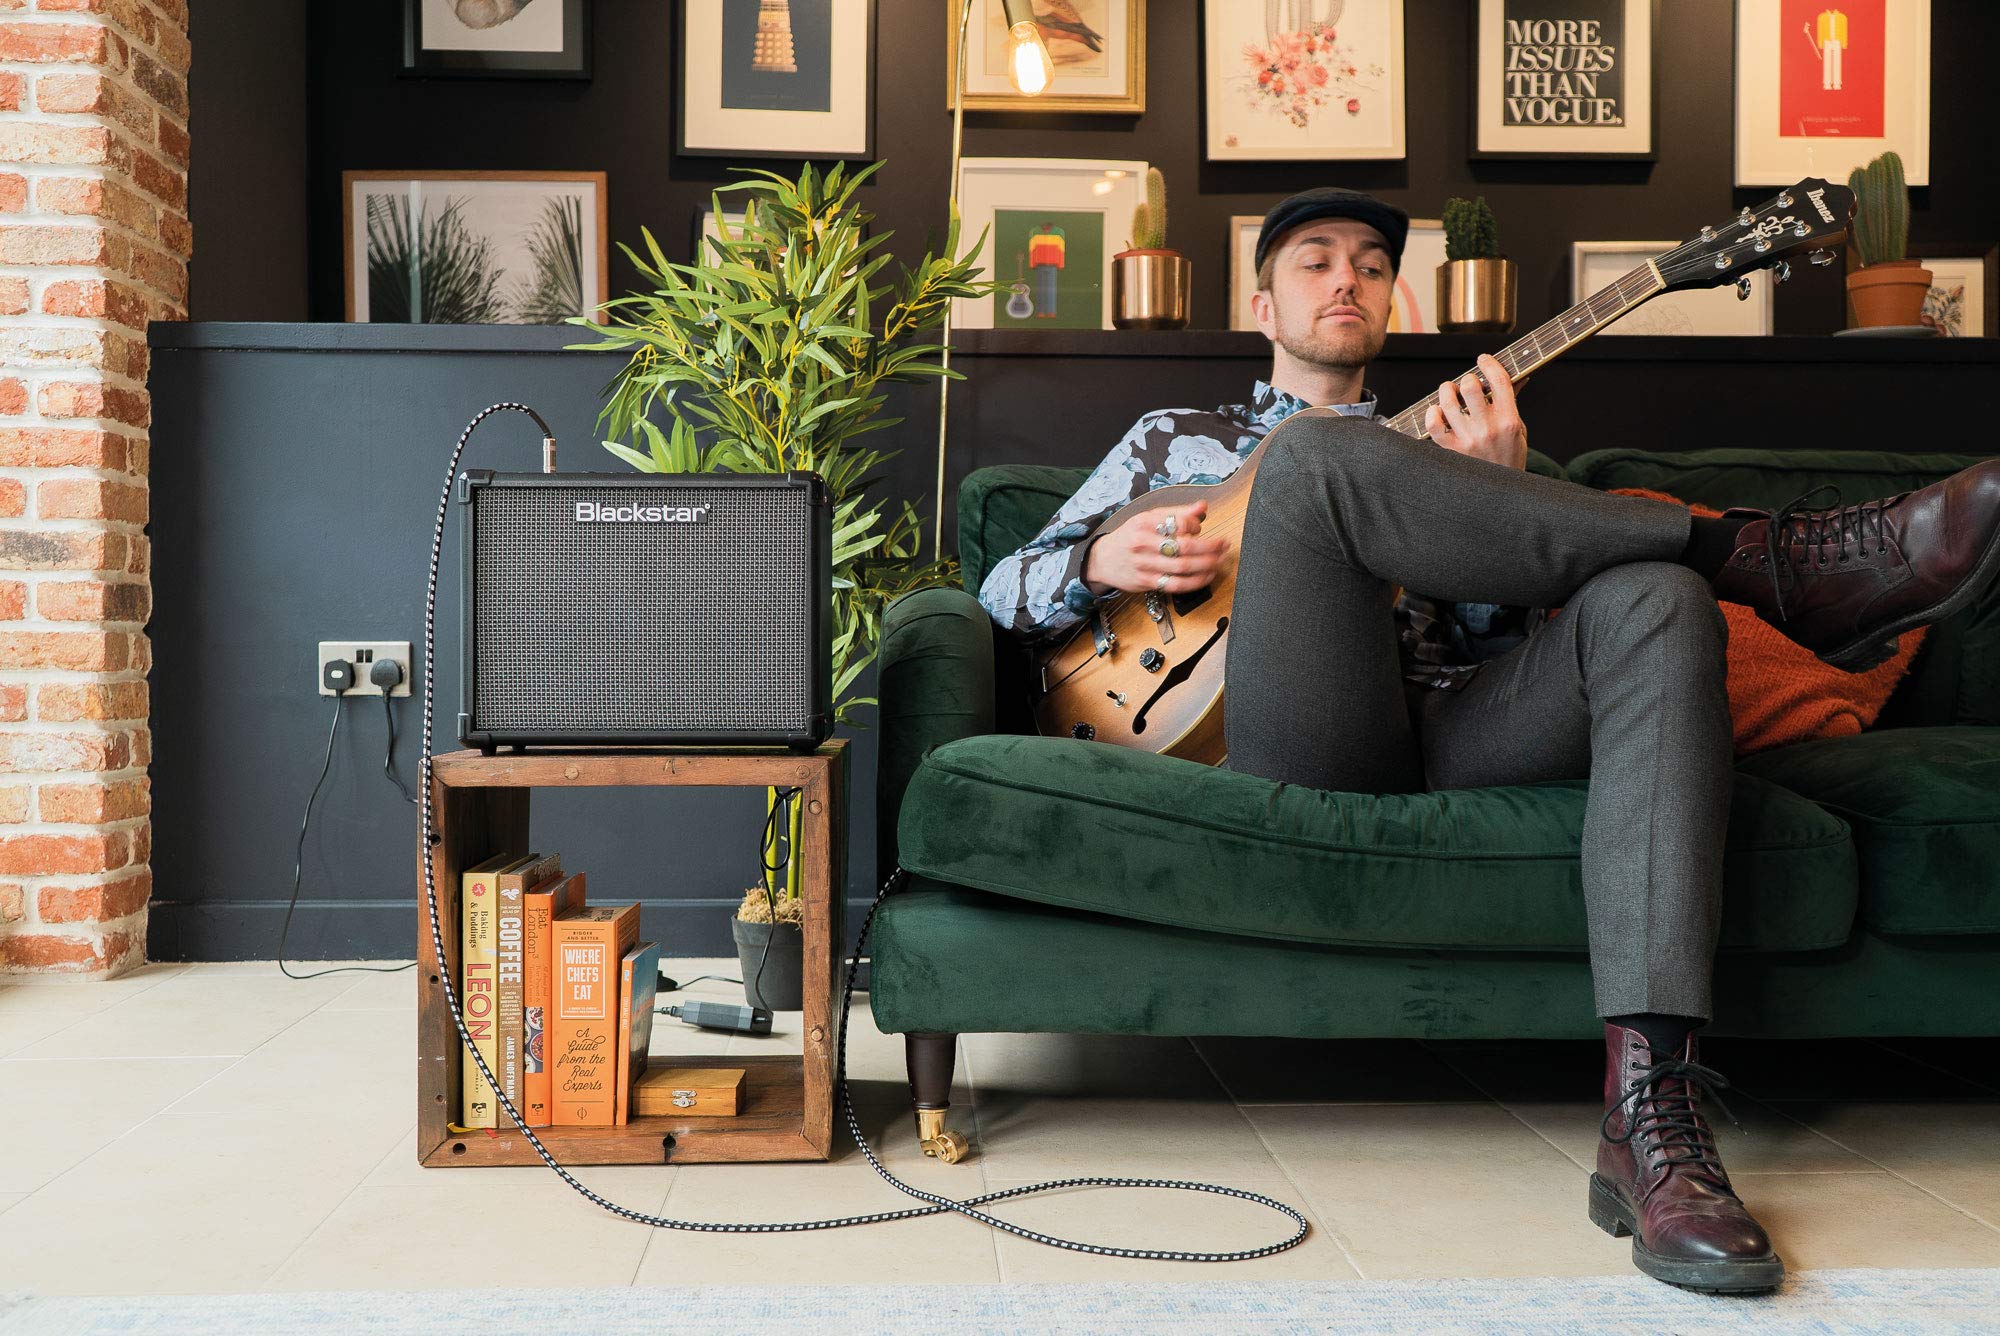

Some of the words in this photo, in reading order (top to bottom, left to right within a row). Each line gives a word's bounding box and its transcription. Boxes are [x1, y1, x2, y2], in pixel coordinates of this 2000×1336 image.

[1505, 20, 1601, 45] MORE
[1505, 45, 1615, 72] ISSUES
[1505, 72, 1600, 98] THAN
[1505, 97, 1623, 124] VOGUE.
[1806, 187, 1836, 224] Ibanez
[576, 502, 707, 522] Blackstar
[469, 911, 479, 949] Puddings
[479, 910, 489, 940] Baking
[538, 907, 549, 930] Eat
[499, 917, 522, 984] COFFEE
[565, 949, 601, 965] WHERE
[567, 967, 599, 982] CHEFS
[466, 963, 492, 1040] LEON
[573, 984, 592, 1000] EAT
[575, 1027, 590, 1038] A
[506, 1036, 515, 1060] JAMES
[568, 1036, 606, 1054] Guide
[556, 1053, 587, 1068] from
[588, 1053, 606, 1064] the
[571, 1065, 596, 1080] Real
[506, 1061, 515, 1100] HOFFMANN
[562, 1079, 603, 1093] Experts
